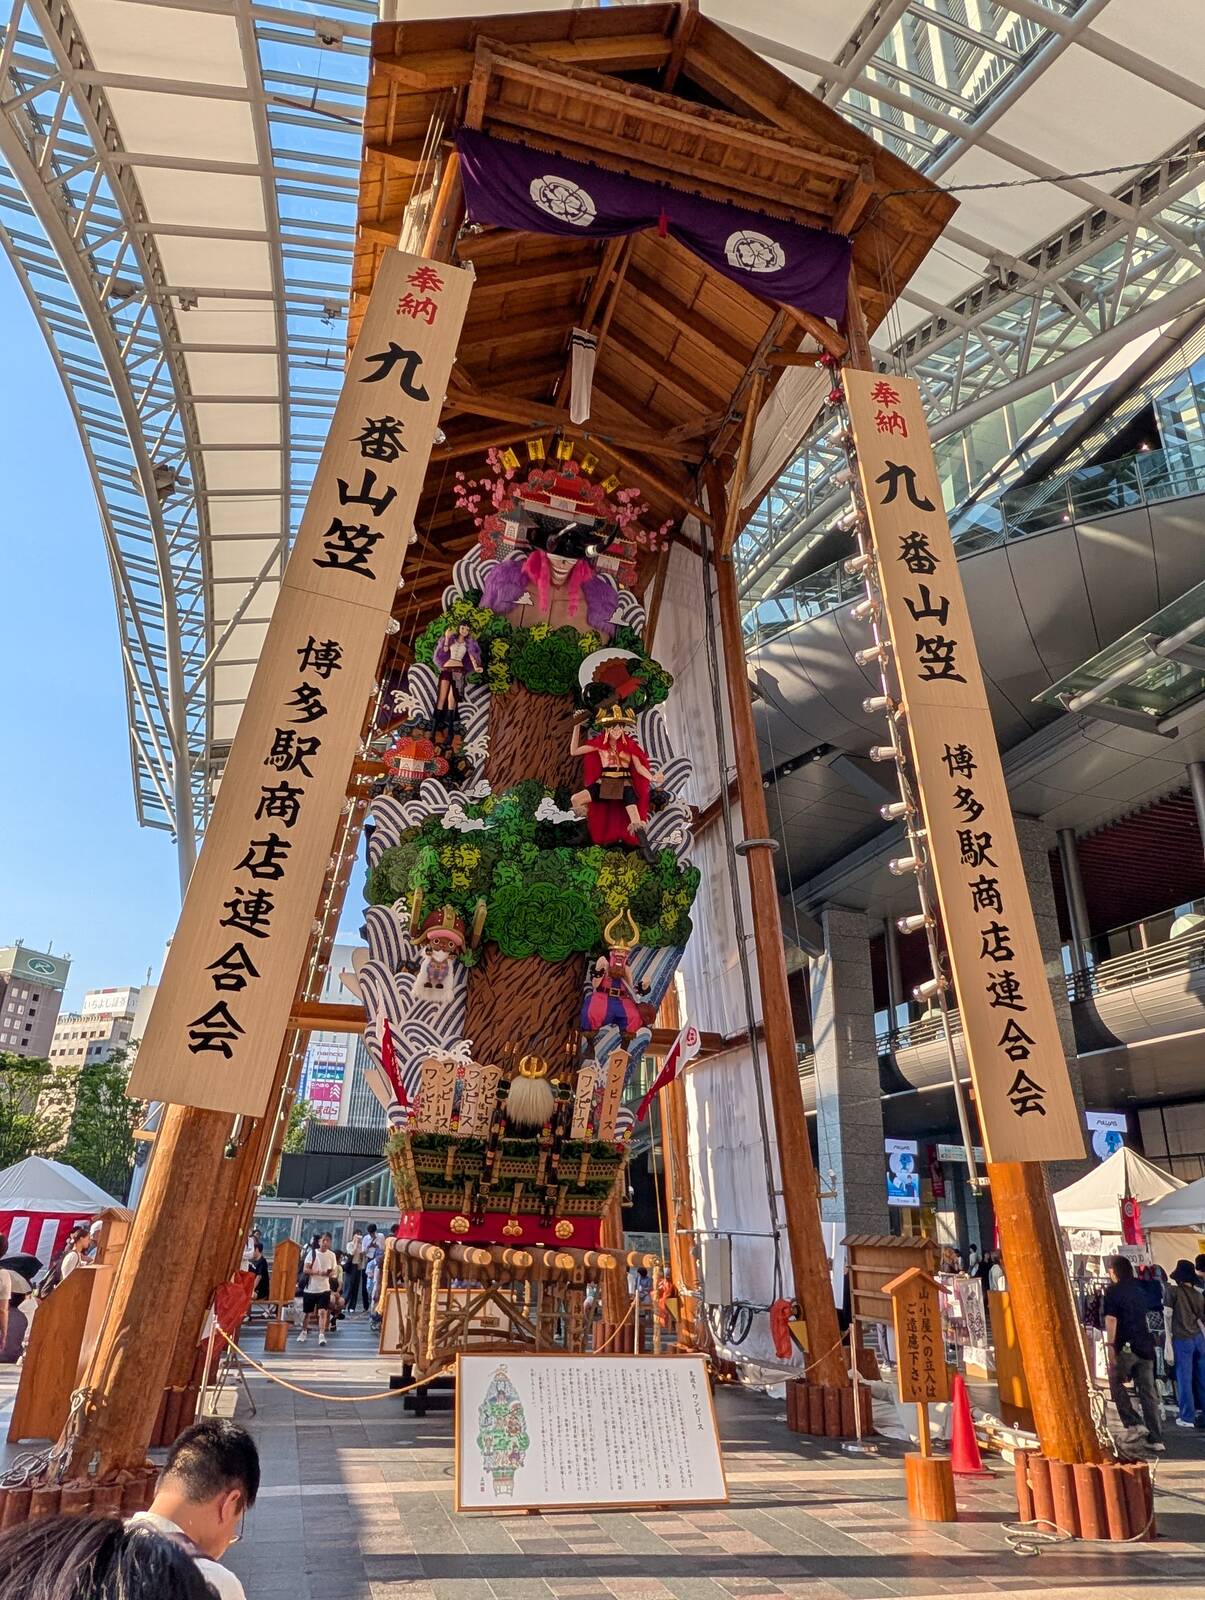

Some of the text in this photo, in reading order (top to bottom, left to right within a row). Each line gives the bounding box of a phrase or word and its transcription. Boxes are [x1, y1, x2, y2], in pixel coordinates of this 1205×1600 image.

[870, 380, 909, 439] 奉納
[875, 460, 968, 684] 九番山笠
[186, 265, 446, 1060] 奉納 九番山笠 博多駅商店連合会
[941, 743, 1048, 1118] 博多駅商店連合会
[440, 1062, 455, 1129] ワンピース
[461, 1070, 480, 1128] ワンピース
[481, 1072, 498, 1126] ワンピース
[576, 1075, 593, 1129] ワンピース
[603, 1058, 623, 1130] ワンピース
[906, 1303, 922, 1396] ご遠慮下さい
[919, 1286, 937, 1398] 山小屋への立入は
